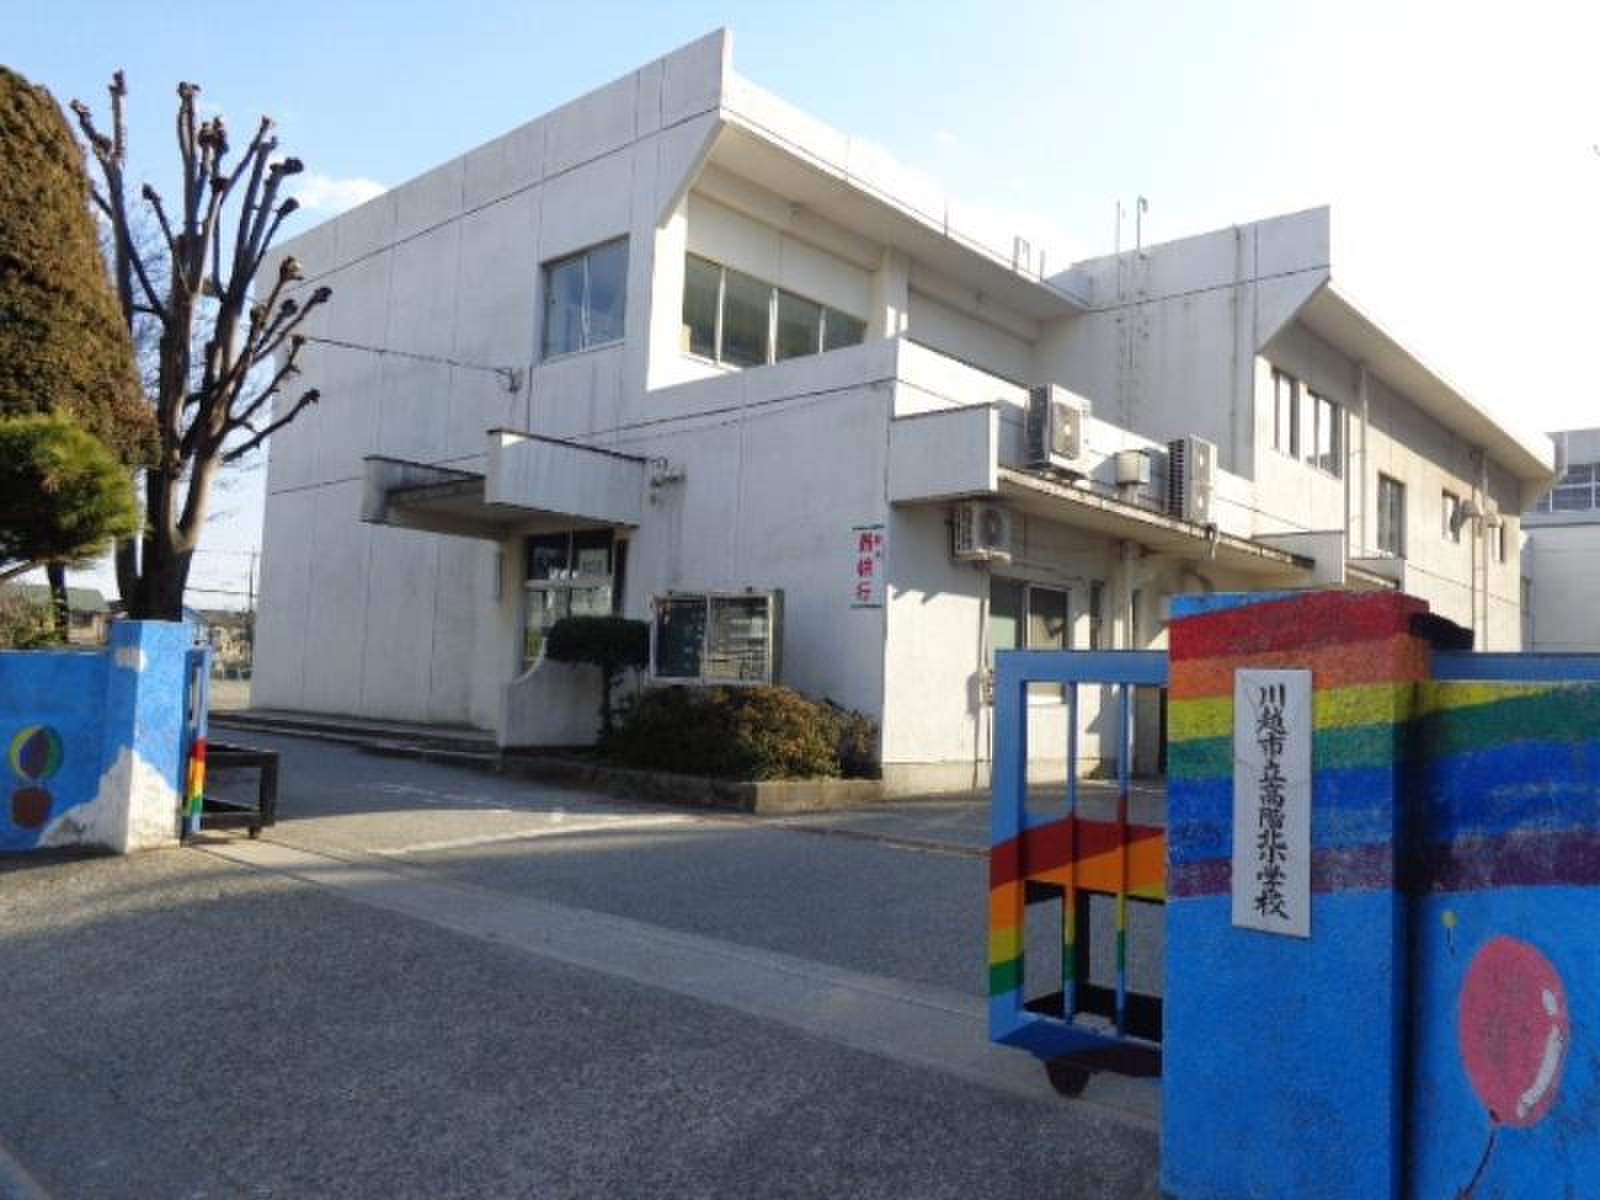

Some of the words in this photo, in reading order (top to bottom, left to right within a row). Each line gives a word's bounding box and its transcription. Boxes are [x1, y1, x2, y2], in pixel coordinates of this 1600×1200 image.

[1253, 683, 1291, 921] 川越市立高階北小学校
